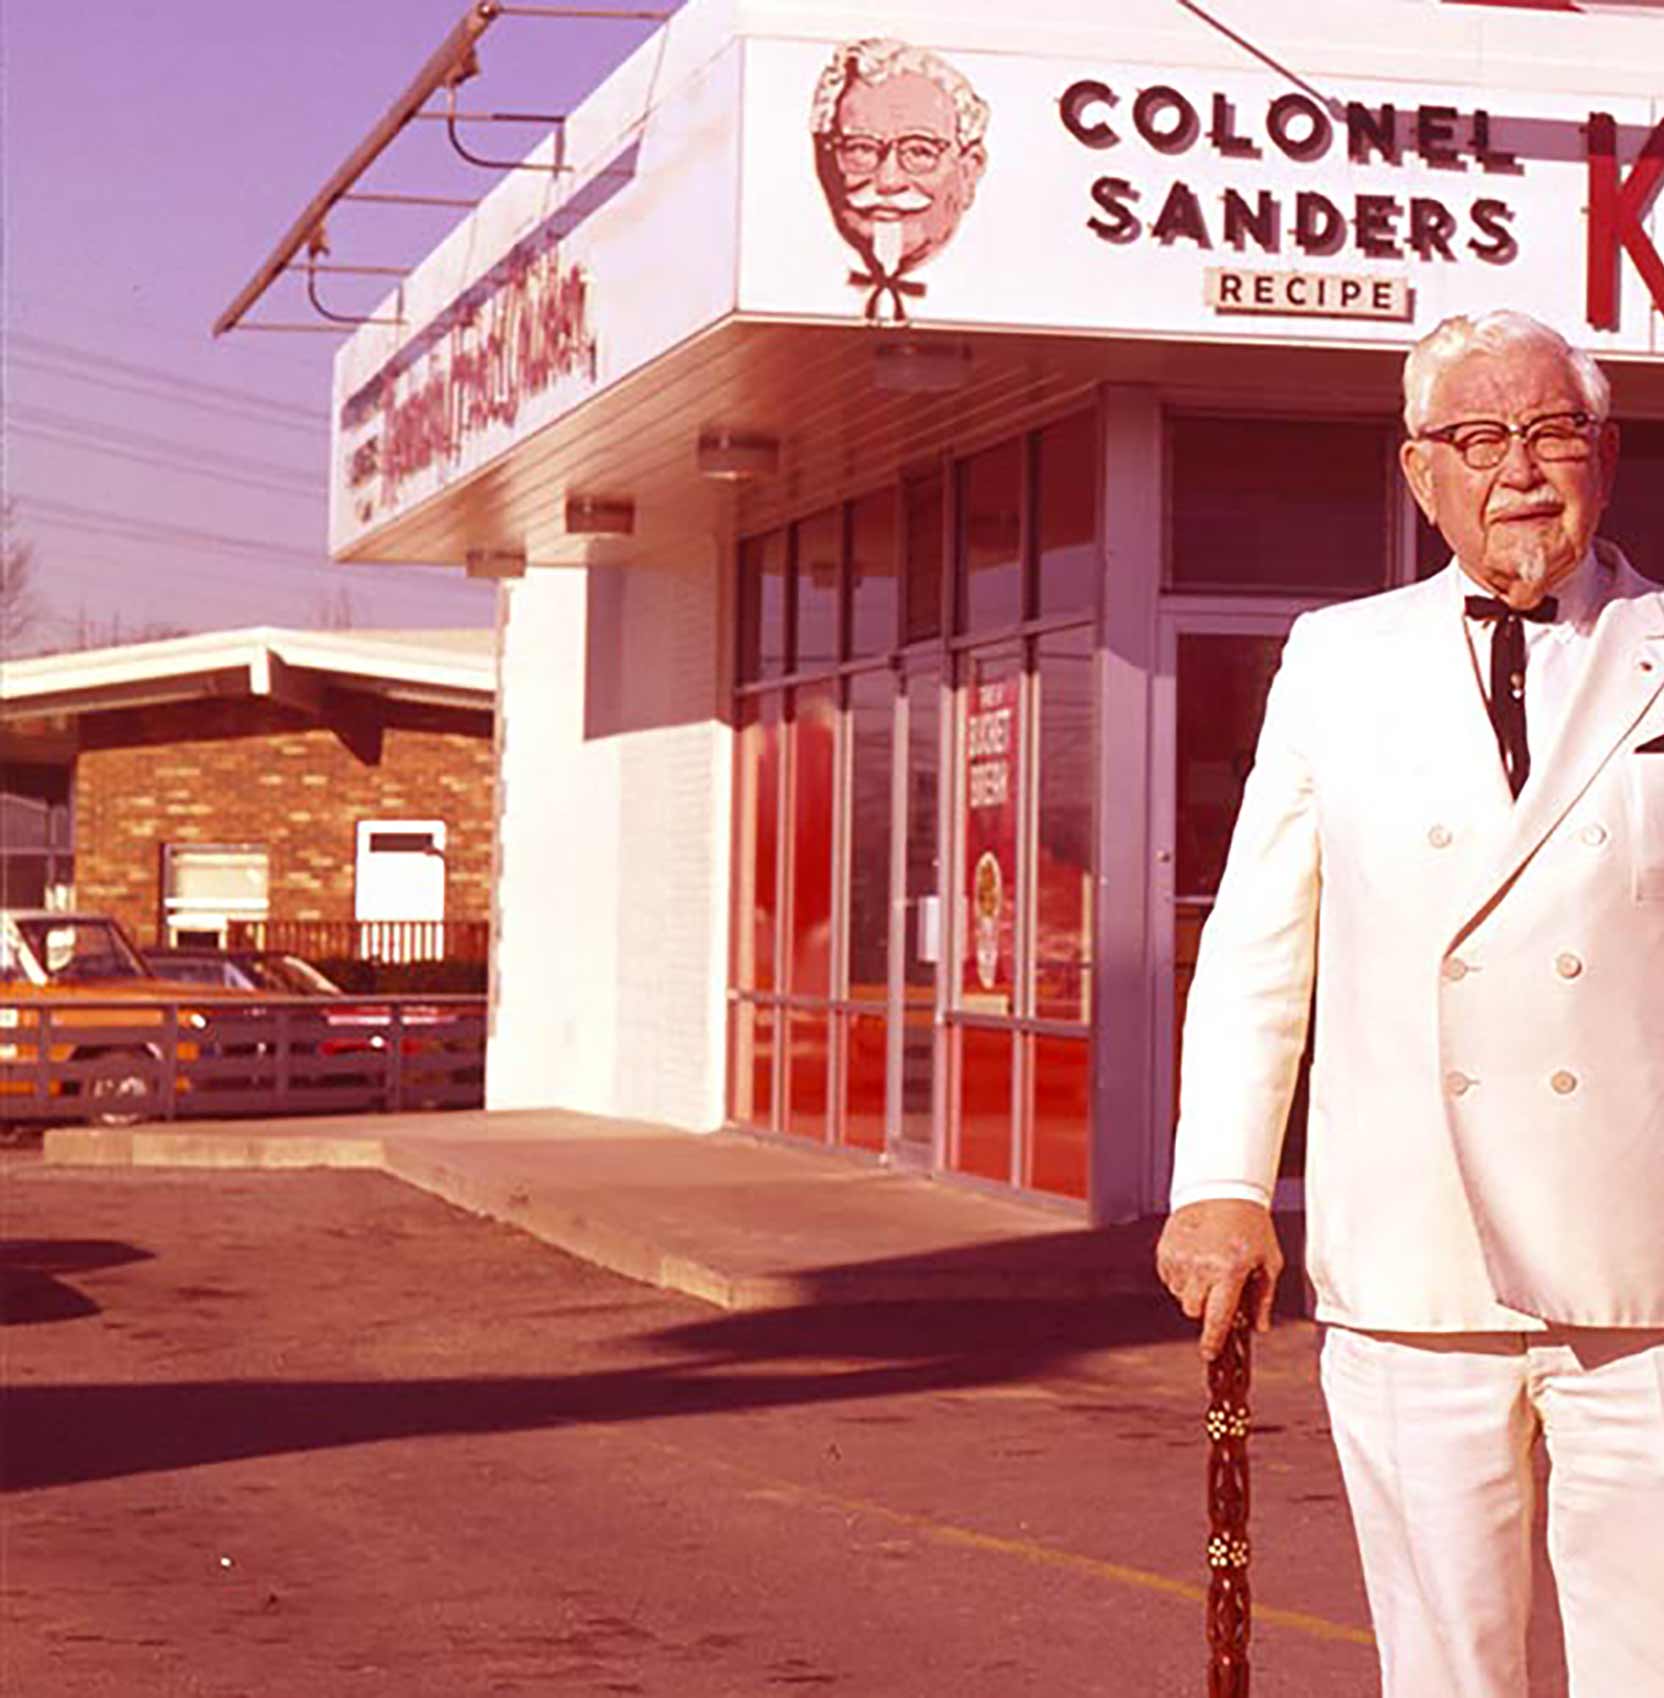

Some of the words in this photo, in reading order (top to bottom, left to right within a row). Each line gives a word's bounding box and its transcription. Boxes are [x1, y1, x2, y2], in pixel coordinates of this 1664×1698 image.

[1060, 79, 1523, 174] COLONEL
[1087, 176, 1518, 265] SANDERS
[1219, 274, 1393, 310] RECIPE
